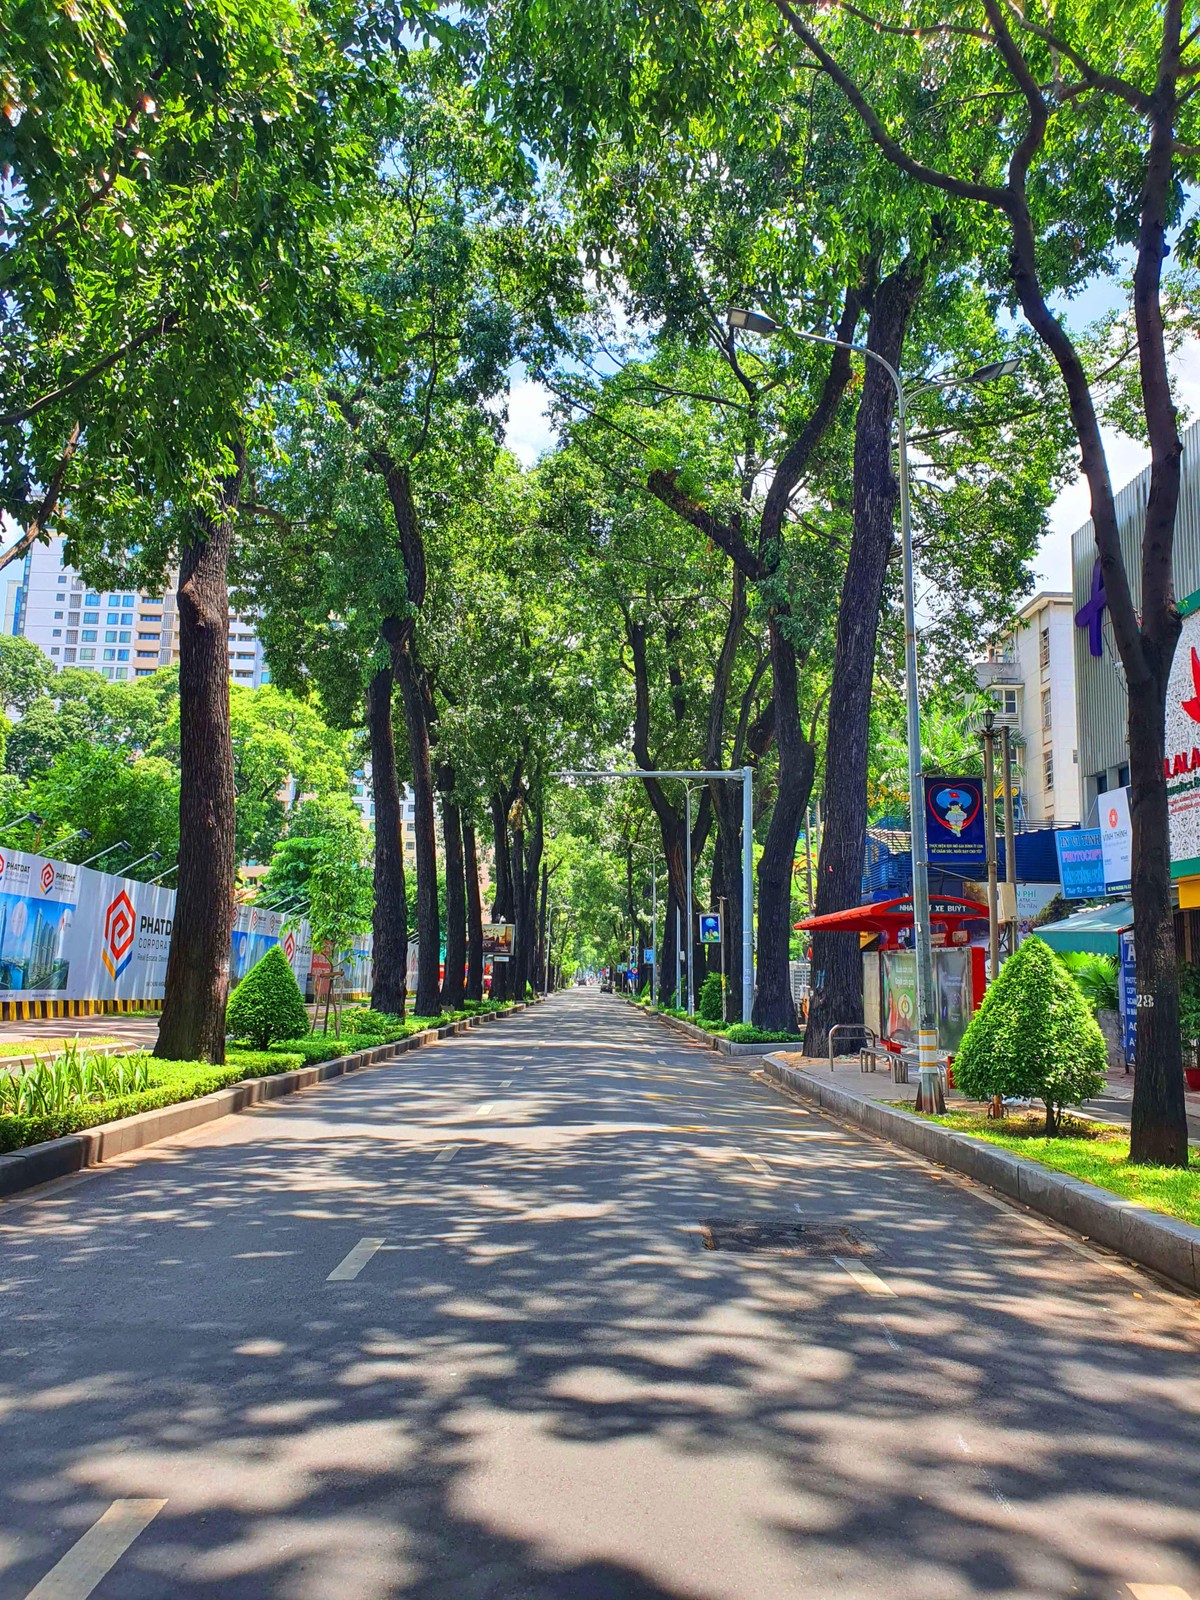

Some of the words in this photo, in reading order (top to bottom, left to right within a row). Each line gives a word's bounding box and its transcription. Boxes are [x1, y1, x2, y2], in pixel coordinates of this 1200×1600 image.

[1060, 836, 1069, 847] IN
[140, 916, 172, 936] PHATD
[138, 938, 171, 950] CORPORA
